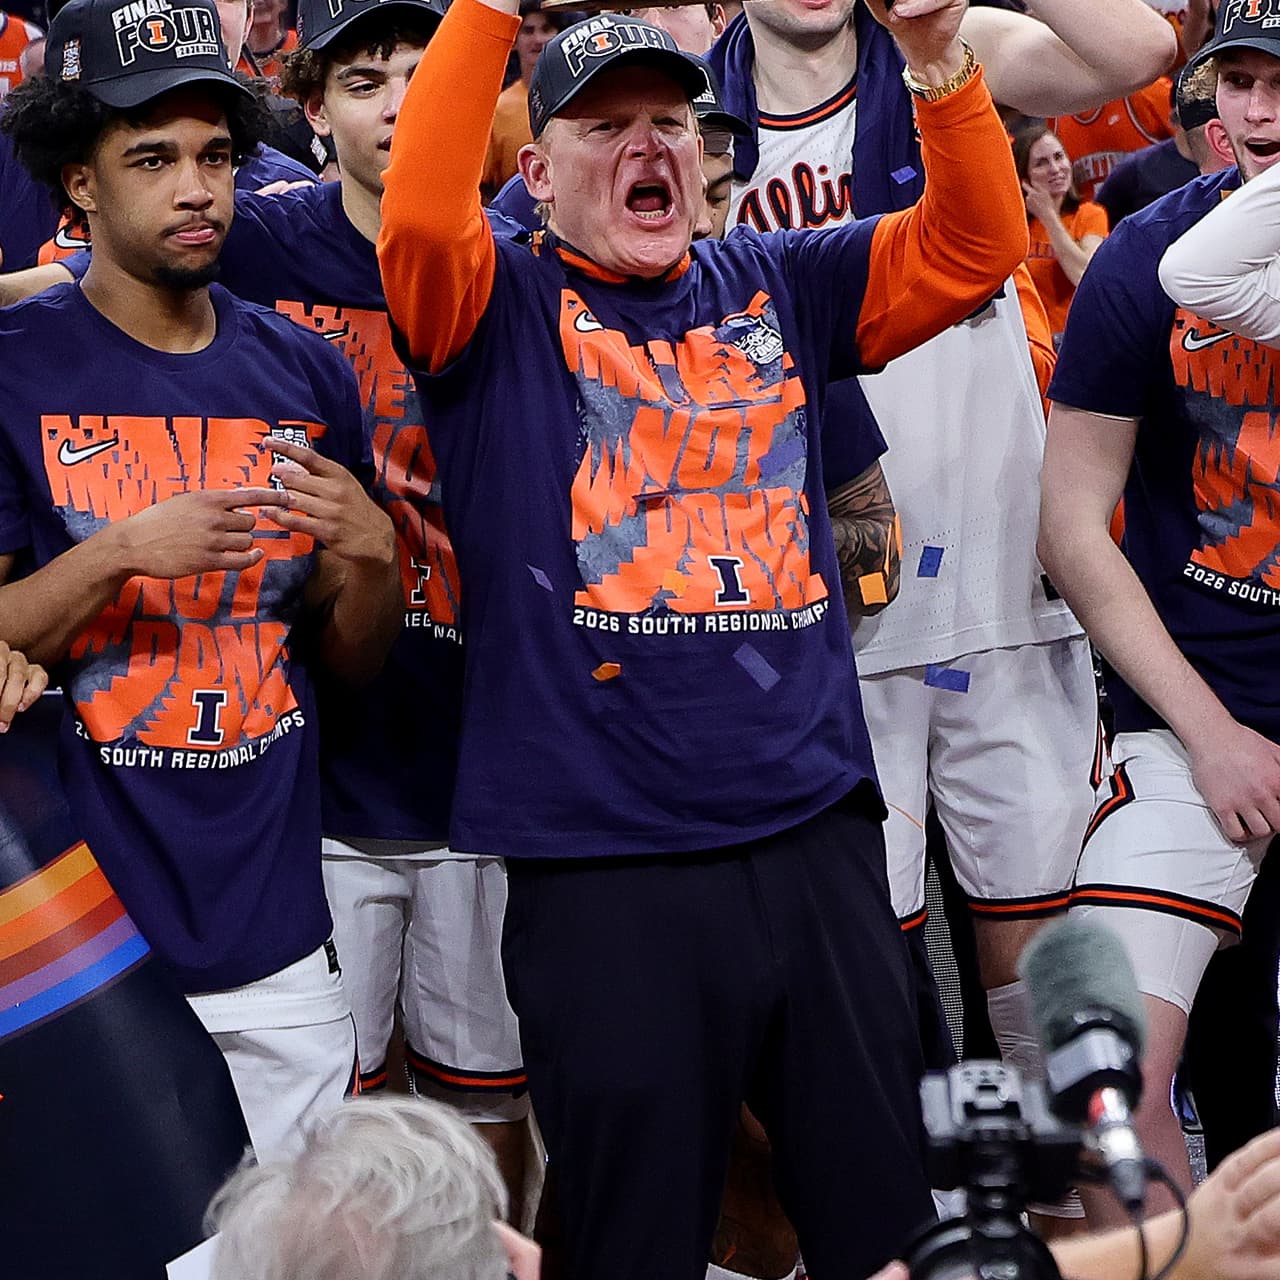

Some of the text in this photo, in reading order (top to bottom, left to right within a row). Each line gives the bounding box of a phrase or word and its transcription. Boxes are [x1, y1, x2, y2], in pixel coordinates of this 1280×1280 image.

[561, 17, 615, 54] FINAL
[628, 405, 765, 489] NOT
[708, 556, 750, 606] I
[1184, 563, 1222, 589] 2026
[573, 608, 620, 632] 2026
[628, 614, 696, 634] SOUTH
[705, 613, 789, 633] REGIONAL
[185, 689, 228, 746] I
[101, 746, 163, 768] SOUTH
[171, 747, 256, 770] REGIONAL
